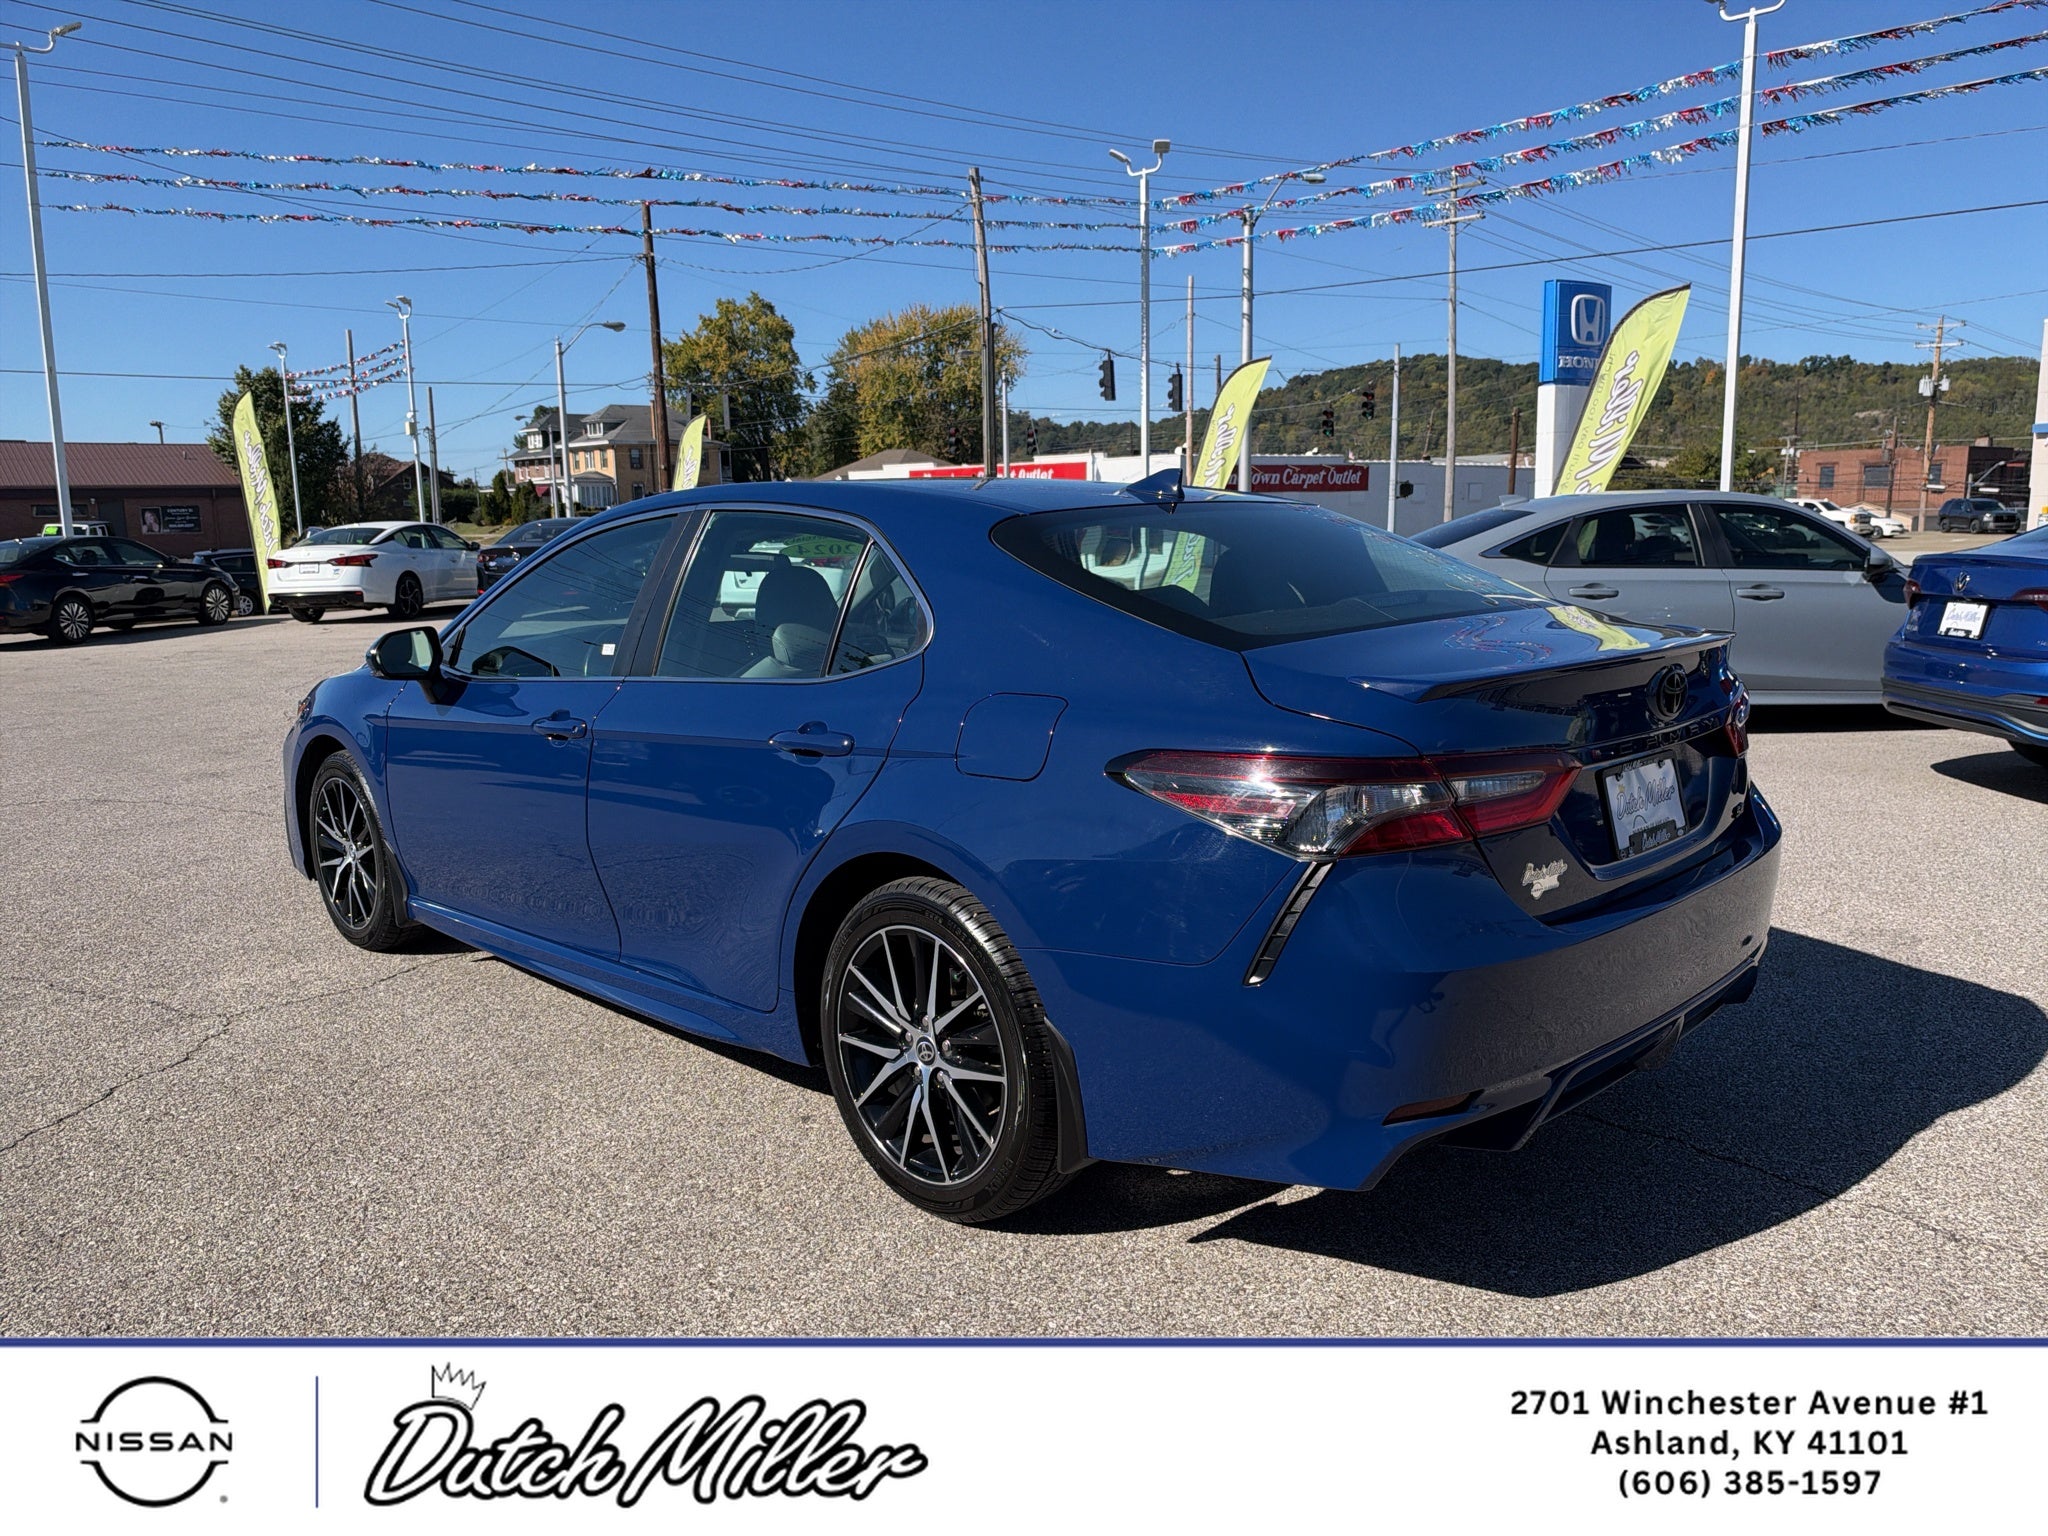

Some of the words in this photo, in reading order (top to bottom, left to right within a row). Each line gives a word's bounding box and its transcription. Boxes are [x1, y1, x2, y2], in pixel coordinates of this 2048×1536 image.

[1558, 355, 1602, 369] HON
[1283, 468, 1326, 489] Carpet
[1328, 468, 1362, 484] Outlet
[1620, 717, 1720, 755] CAMRY
[1616, 791, 1645, 821] Dutch
[1643, 776, 1676, 811] Miller
